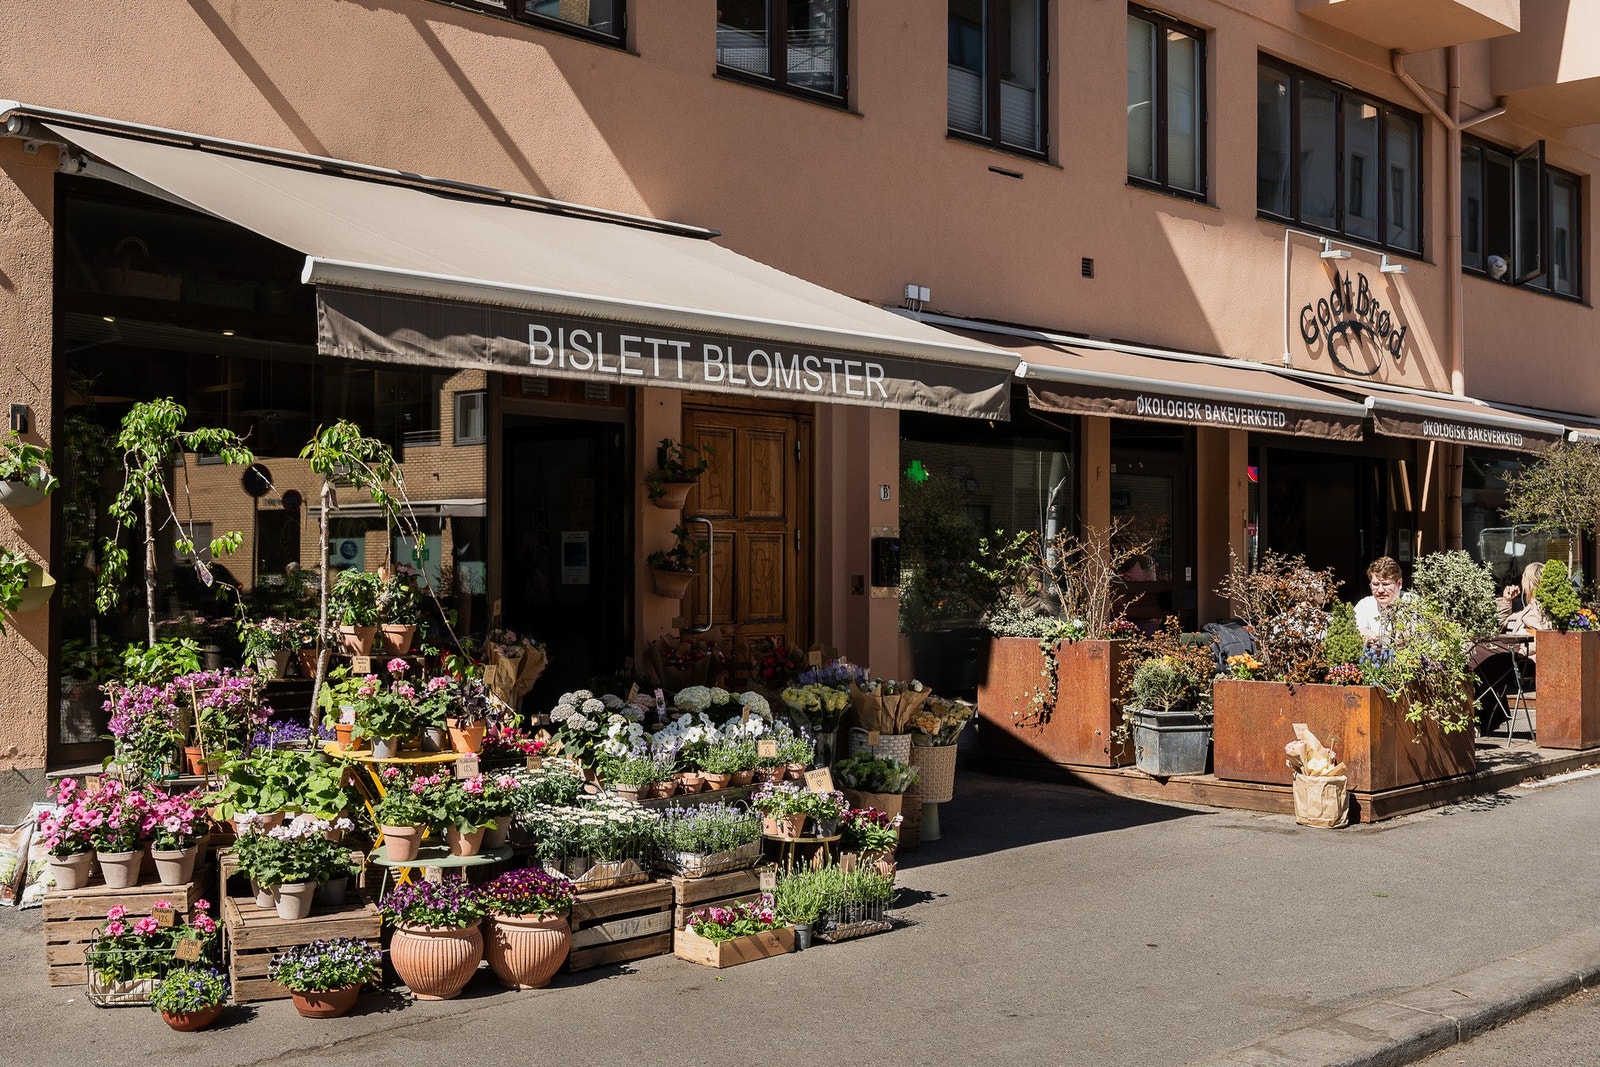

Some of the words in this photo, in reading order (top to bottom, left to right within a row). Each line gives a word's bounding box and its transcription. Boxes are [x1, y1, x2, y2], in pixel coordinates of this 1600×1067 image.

[1300, 270, 1351, 345] Godt
[1355, 272, 1407, 360] Brød
[528, 323, 691, 379] BISLETT
[703, 343, 888, 398] BLOMSTER
[1136, 395, 1202, 420] ØKOLOGISK
[1205, 404, 1286, 428] BAKEVERKSTED
[1422, 419, 1467, 440] ØKOLOGISK
[1468, 428, 1523, 447] BAKEVERKSTED
